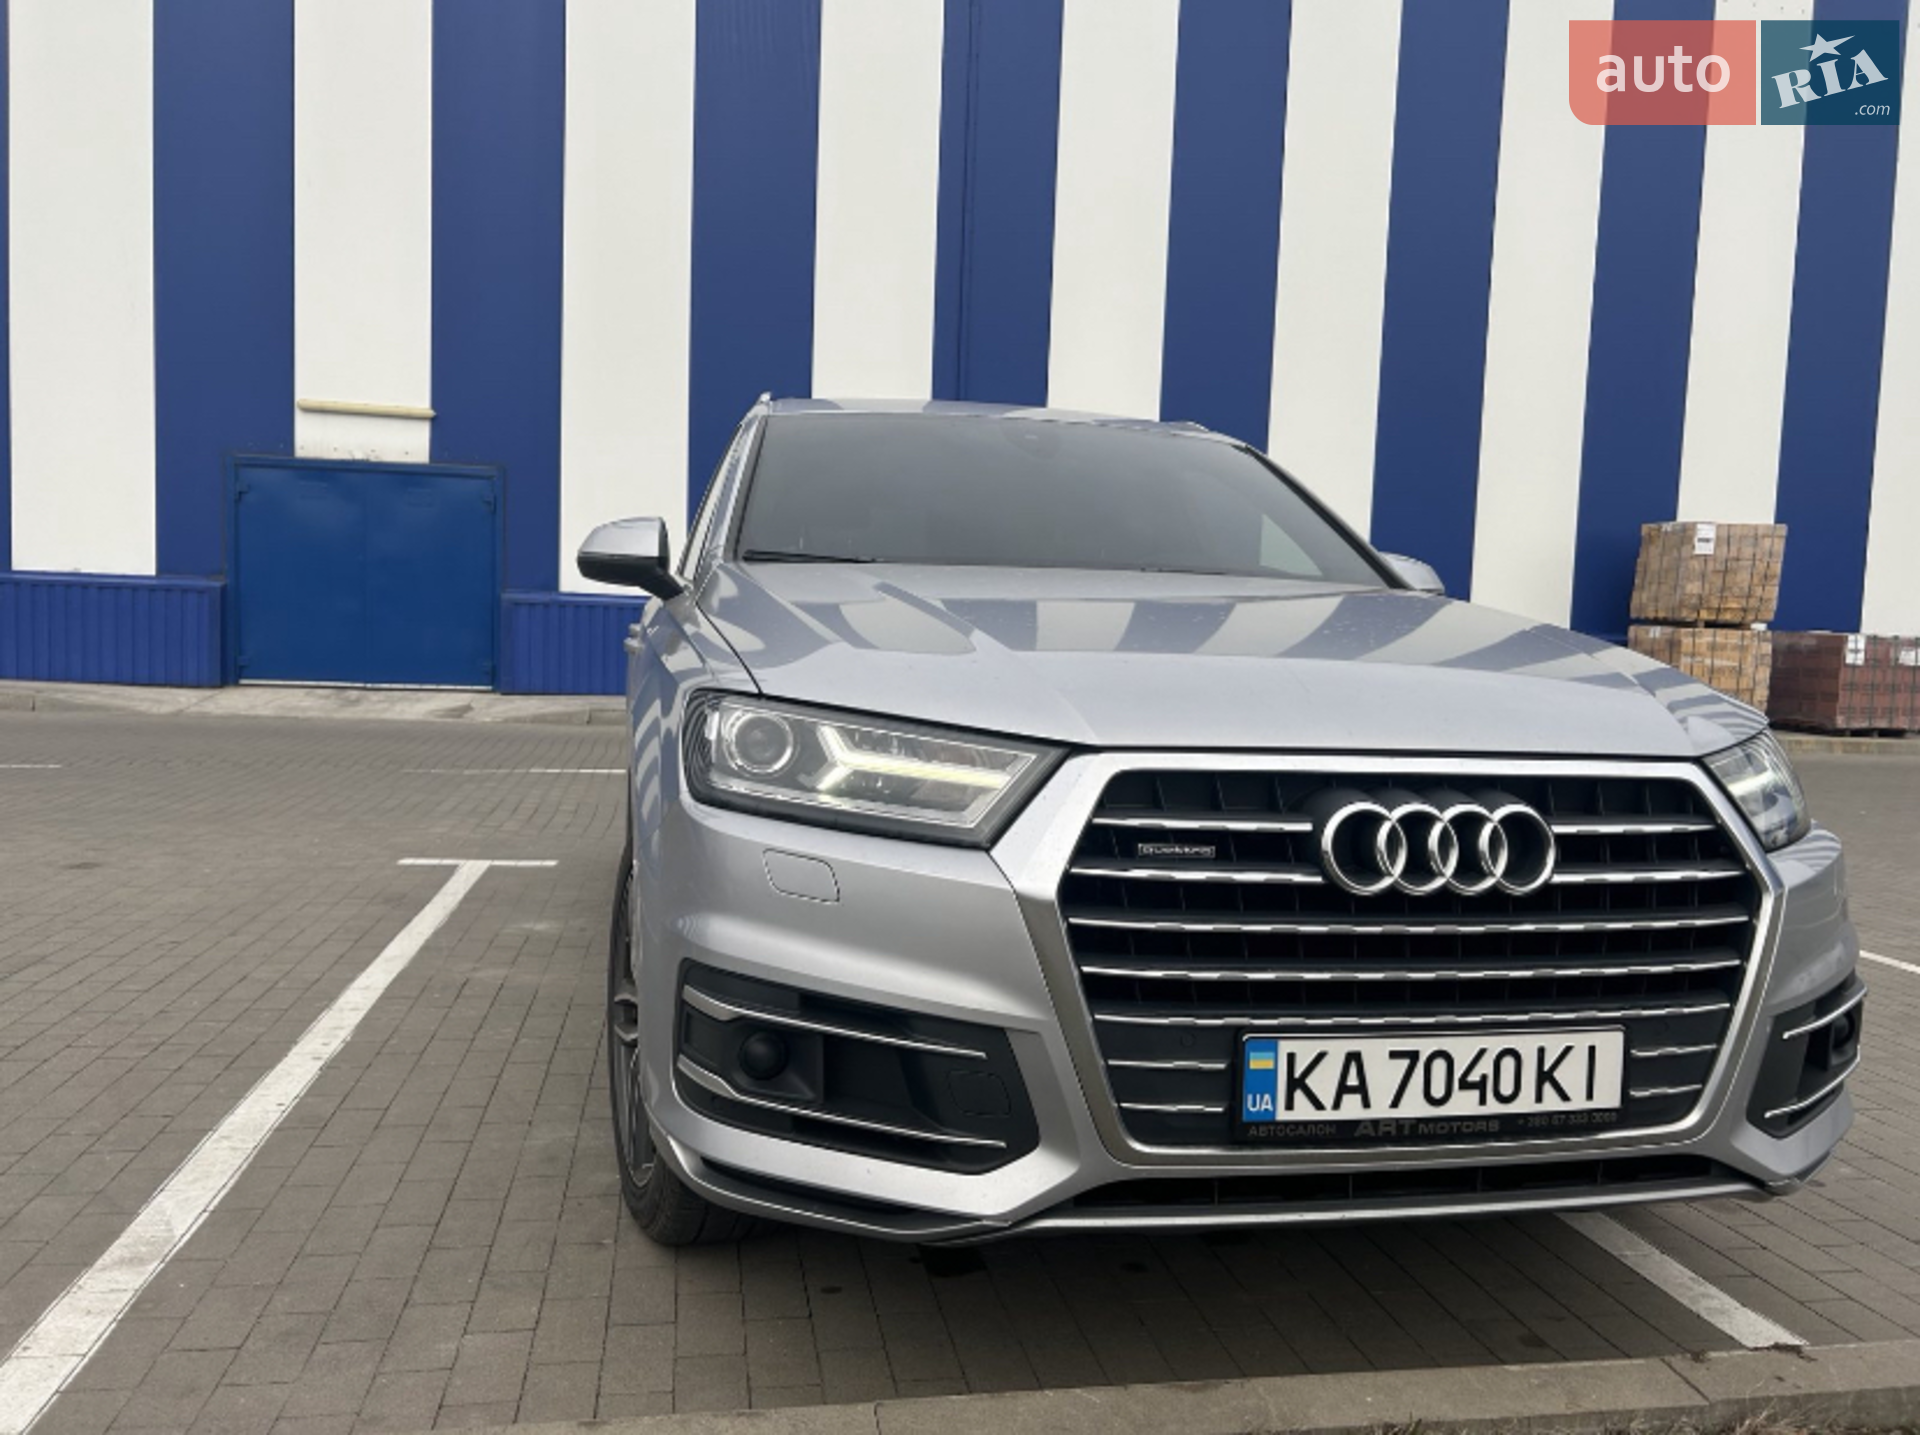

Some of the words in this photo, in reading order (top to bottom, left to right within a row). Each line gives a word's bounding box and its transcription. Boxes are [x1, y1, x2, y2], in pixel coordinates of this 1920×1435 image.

[1284, 1051, 1371, 1112] KA
[1388, 1047, 1523, 1109] 7040
[1534, 1045, 1597, 1104] KI
[1247, 1094, 1273, 1112] UA
